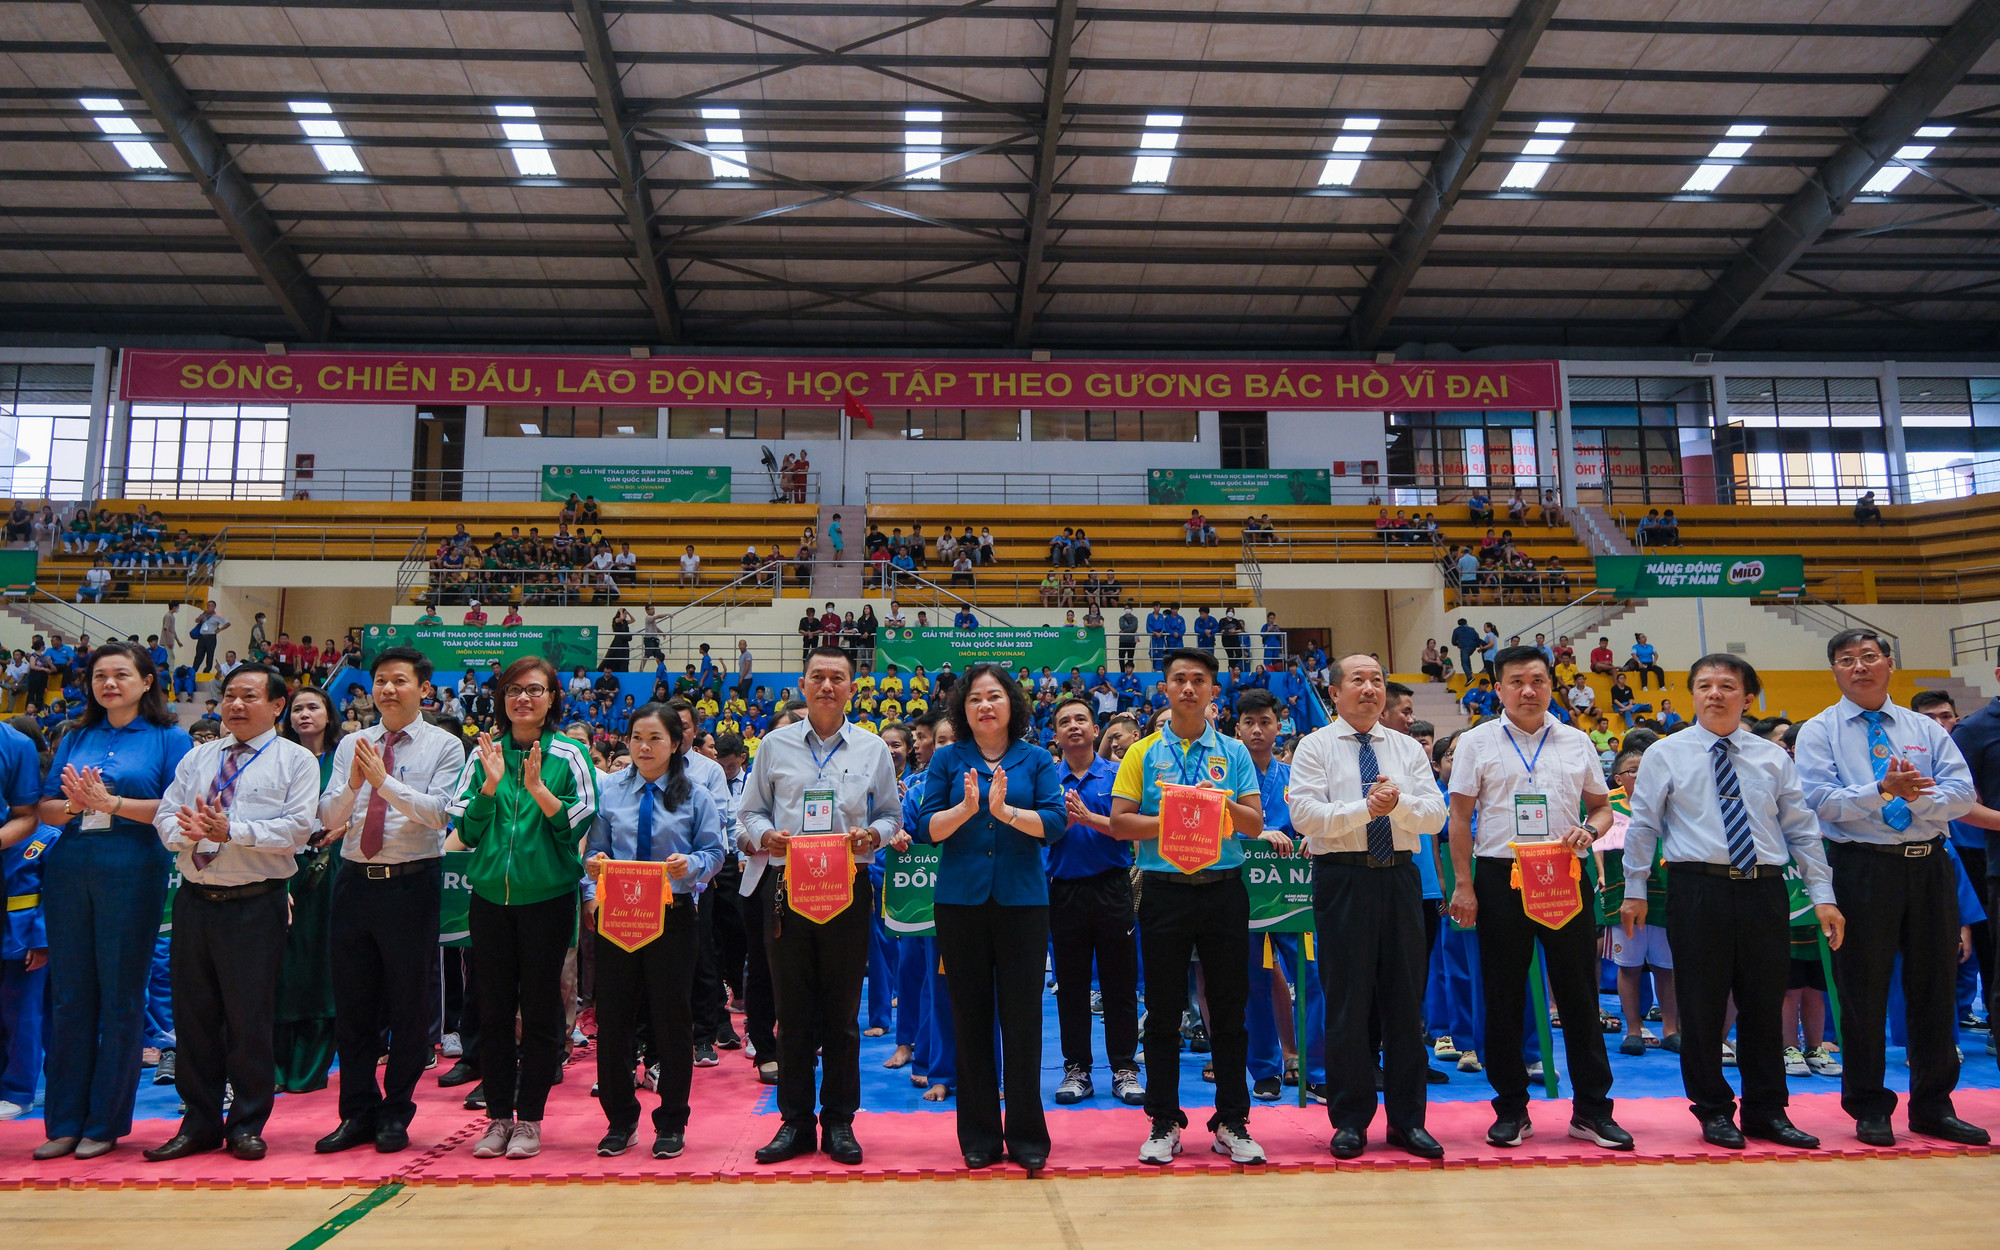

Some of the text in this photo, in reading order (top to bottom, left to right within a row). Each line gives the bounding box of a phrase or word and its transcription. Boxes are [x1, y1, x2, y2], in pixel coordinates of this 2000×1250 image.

[179, 359, 1509, 404] SỐNG, CHIẾN ĐẤU, LAO ĐỘNG, HỌC TẬP THEO GƯƠNG BÁC HỒ VĨ ĐẠI
[1646, 561, 1723, 577] NĂNG ĐỘNG
[1732, 567, 1762, 579] MILO
[1657, 574, 1720, 587] VIỆT NAM
[468, 632, 483, 640] HỌC
[921, 629, 938, 638] GIẢI
[978, 631, 994, 640] HỌC
[1015, 629, 1031, 638] PHỔ
[1033, 630, 1060, 638] THÔNG
[463, 640, 483, 648] QUỐC
[951, 640, 972, 648] TOÀN
[973, 640, 995, 649] QUỐC
[996, 640, 1014, 648] NĂM
[822, 805, 830, 815] B
[1535, 809, 1544, 818] B
[898, 853, 939, 863] SỞ GIÁO
[1244, 849, 1252, 859] Ở
[1254, 849, 1278, 859] GIÁO
[893, 866, 938, 888] ĐỒN
[1248, 863, 1283, 884] ĐÀ
